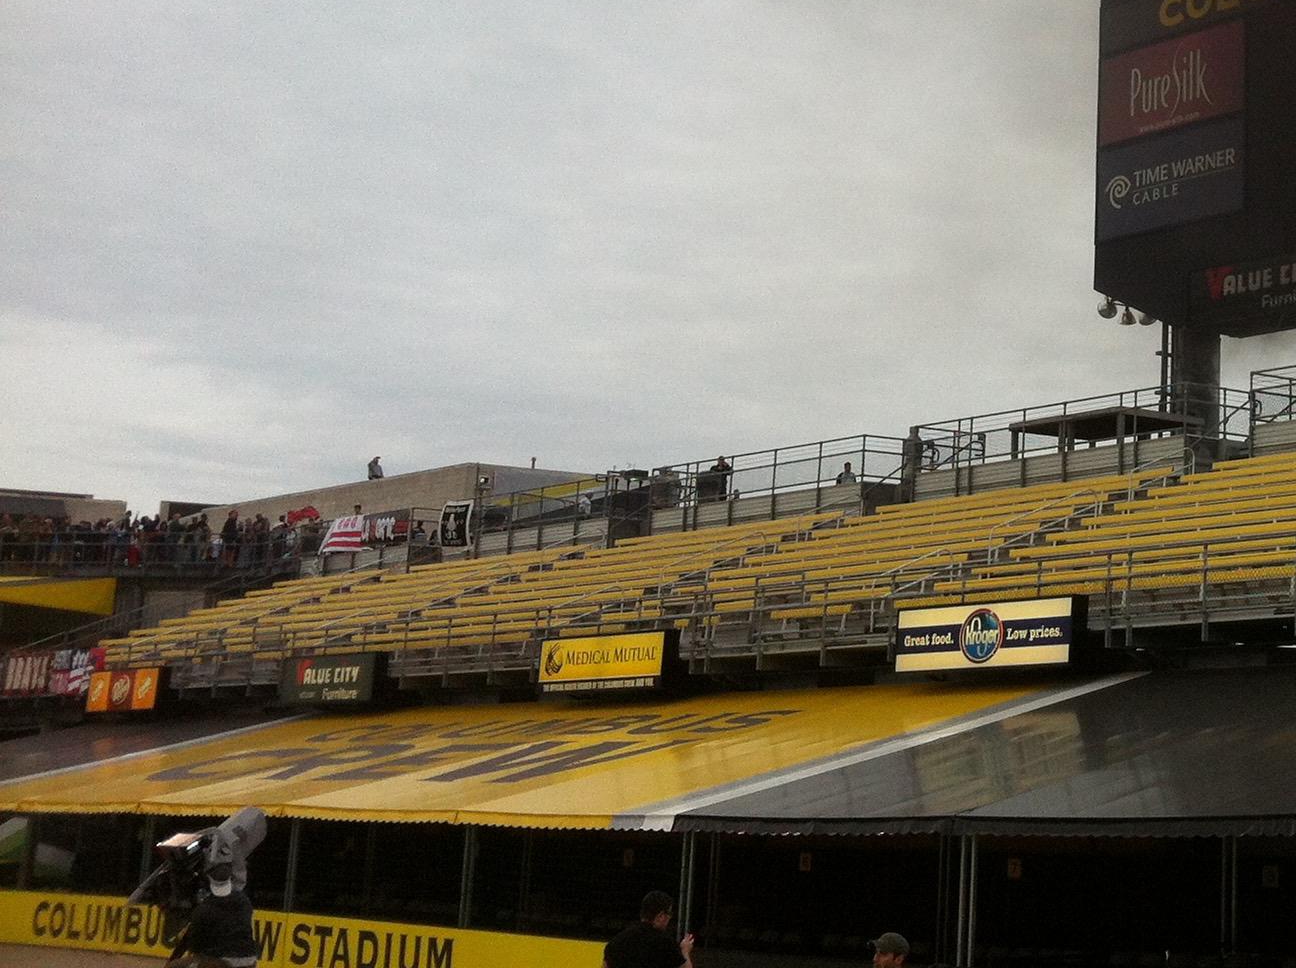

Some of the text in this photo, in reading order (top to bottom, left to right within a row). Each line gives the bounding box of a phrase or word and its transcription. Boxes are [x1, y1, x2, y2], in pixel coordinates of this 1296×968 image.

[1133, 148, 1236, 187] TIME WARNER
[1132, 183, 1180, 206] CABLE
[1205, 265, 1273, 302] VALUE
[904, 633, 954, 648] Great food.
[965, 617, 998, 657] Kroger
[1006, 625, 1063, 642] Low prices.
[565, 645, 658, 666] MEDICAL MUTUAL
[296, 659, 361, 687] VALUE CITY
[146, 737, 705, 783] CREW
[290, 923, 455, 967] STADIUM
